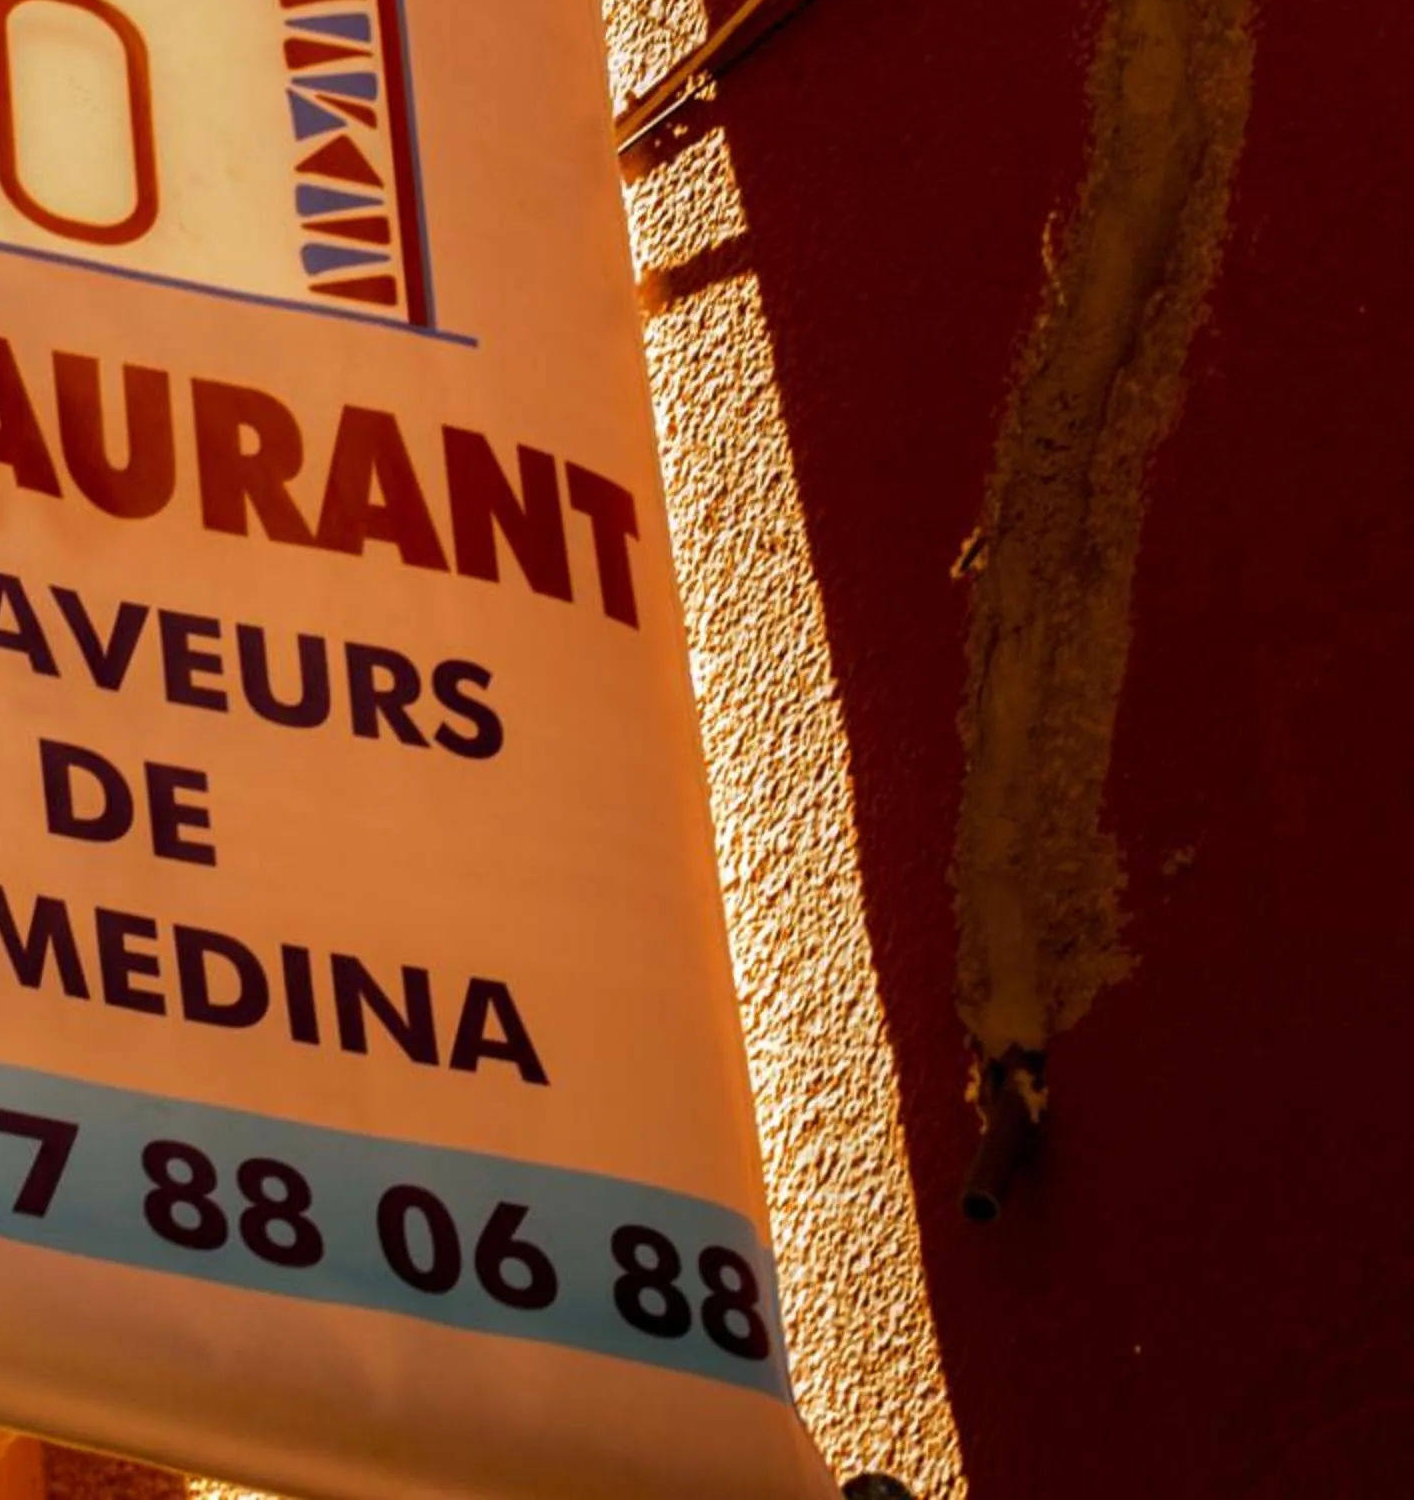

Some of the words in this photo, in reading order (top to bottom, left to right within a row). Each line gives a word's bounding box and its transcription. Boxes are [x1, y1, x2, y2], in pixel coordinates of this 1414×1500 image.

[38, 738, 217, 867] DE
[141, 1139, 324, 1271] 88
[375, 1184, 560, 1312] 06
[610, 1223, 771, 1362] 88
